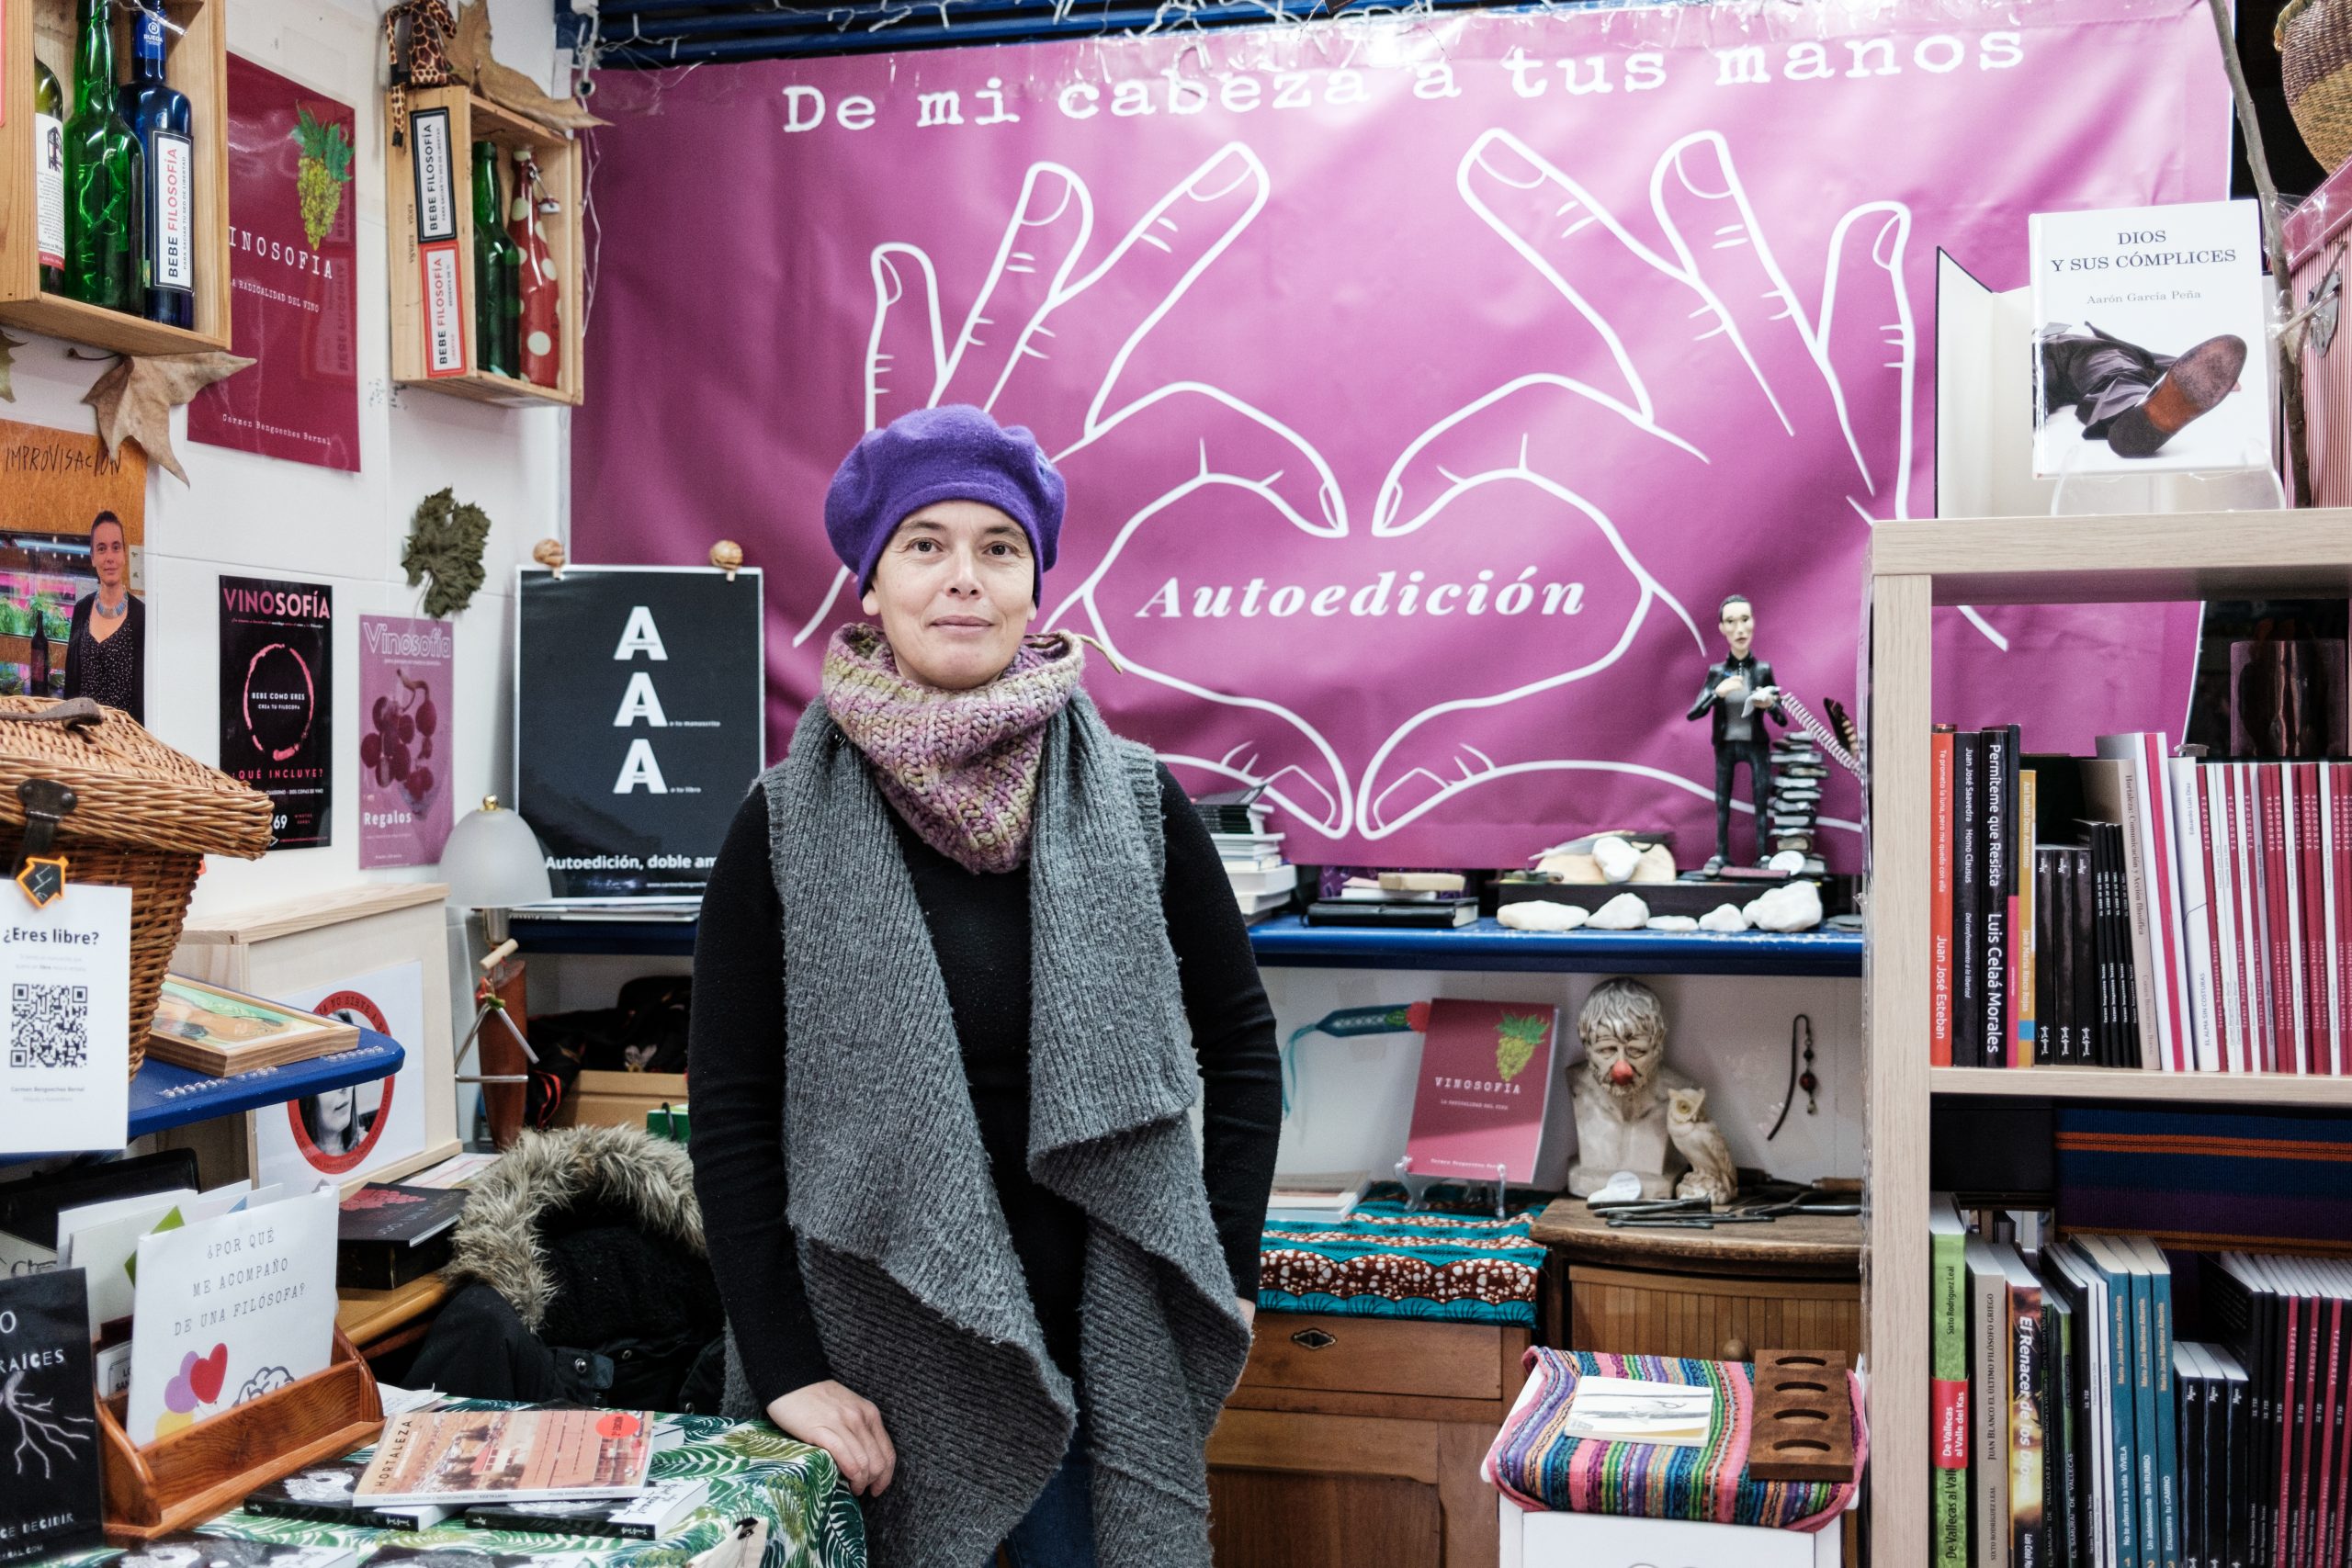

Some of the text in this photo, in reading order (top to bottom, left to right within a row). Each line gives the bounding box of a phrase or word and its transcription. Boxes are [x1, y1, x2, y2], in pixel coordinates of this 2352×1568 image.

[143, 34, 163, 42] RUEDA
[783, 28, 2026, 133] De mi cabeza a tus manos
[424, 123, 438, 231] BEBE FILOSOFÍA
[166, 148, 178, 277] BEBE FILOSOFÍA
[229, 226, 333, 279] INOSOFIA
[2117, 230, 2166, 245] DIOS
[2051, 250, 2237, 272] Y SUS CÓMPLICES
[238, 281, 286, 302] RADICALIDAD
[288, 295, 301, 307] DEL
[303, 299, 319, 313] VINO
[435, 258, 447, 365] BEBE FILOSOFÍA
[2086, 289, 2201, 305] Aarón García Peña
[222, 413, 253, 428] Carmen
[303, 432, 332, 446] Bernal
[223, 588, 331, 620] VINOSOFÍA
[1135, 565, 1585, 618] Autoedición
[363, 622, 451, 658] Vinosofía
[613, 606, 668, 660] A
[613, 672, 668, 727] A
[613, 739, 668, 794] A
[1940, 750, 1946, 758] Te
[269, 768, 323, 779] INCLUYE?
[1938, 759, 1946, 789] prometo
[1965, 747, 1974, 822] Juan José Saavedra
[2125, 775, 2136, 814] Hortaleza:
[273, 814, 288, 830] 69
[363, 810, 412, 828] Regalos
[1988, 744, 2002, 886] Permíteme que Resista
[2227, 795, 2236, 851] VINOSOFIA
[2274, 795, 2283, 851] VINOSOFIA
[1939, 832, 1945, 842] me
[2128, 816, 2139, 868] Comunicación
[545, 855, 644, 870] Autoedición,
[647, 855, 691, 869] doble
[1938, 843, 1946, 865] quedo
[1965, 829, 1973, 883] Homo Clausus
[2133, 876, 2143, 901] Acción
[2136, 902, 2146, 935] filosófica
[3, 927, 99, 945] ¿Eres libre?
[2022, 930, 2030, 945] José
[2022, 946, 2030, 968] María
[1935, 935, 1947, 1039] Juan José Esteban
[1987, 914, 2003, 1053] Luis Celaá Morales
[2021, 992, 2030, 1011] Rojas
[1435, 1077, 1521, 1094] VINOSOFIA
[207, 1227, 274, 1259] ¿POR QUÉ
[193, 1258, 288, 1297] ME ACOMPAÑO
[1946, 1266, 1954, 1280] Leal
[0, 1310, 17, 1333] O
[175, 1282, 306, 1337] DE UNA FILÓSOFA?
[2019, 1316, 2032, 1331] El
[1985, 1293, 1997, 1461] JUAN BLANCO EL ÚLTIMO FILÓSOFO GRIEGO
[2019, 1335, 2032, 1394] Renacer
[1955, 1392, 1965, 1457] al Valle del Kas
[2020, 1402, 2033, 1419] de
[1943, 1407, 1952, 1456] De Vallecas
[2020, 1424, 2033, 1445] los
[375, 1420, 413, 1487] HORTALEZA
[2120, 1446, 2128, 1472] VÍVELA
[1945, 1491, 1957, 1500] al
[2122, 1490, 2129, 1499] la
[2163, 1476, 2171, 1505] CAMINO
[22, 1513, 73, 1534] DECIDIR
[1945, 1503, 1957, 1545] Vallecas
[1945, 1545, 1957, 1558] De
[2123, 1536, 2130, 1545] No
[2146, 1541, 2153, 1550] Un
